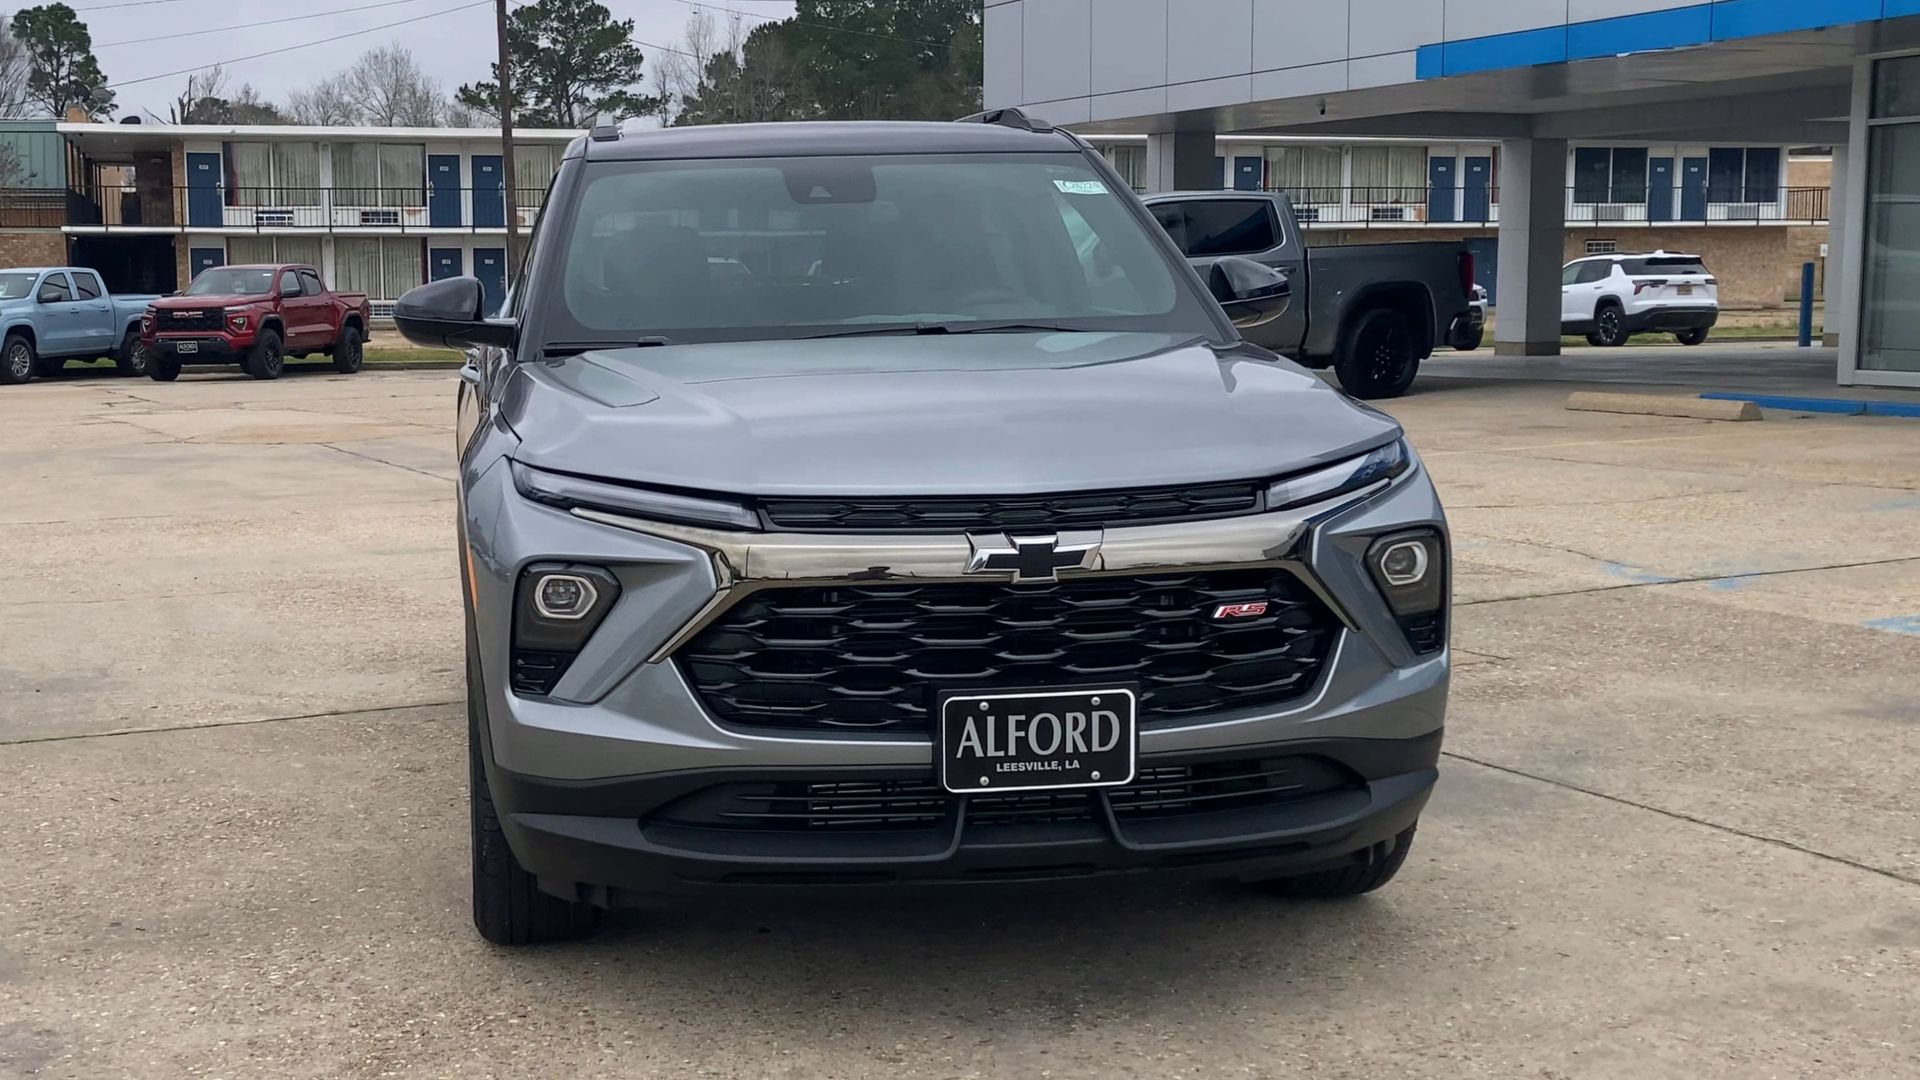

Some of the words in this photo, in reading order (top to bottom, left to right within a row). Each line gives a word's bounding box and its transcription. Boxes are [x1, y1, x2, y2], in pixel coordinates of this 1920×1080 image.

[1213, 601, 1268, 618] RS
[956, 710, 1120, 758] ALFORD
[996, 760, 1062, 772] LEESVILLE,
[1065, 760, 1080, 769] LA
